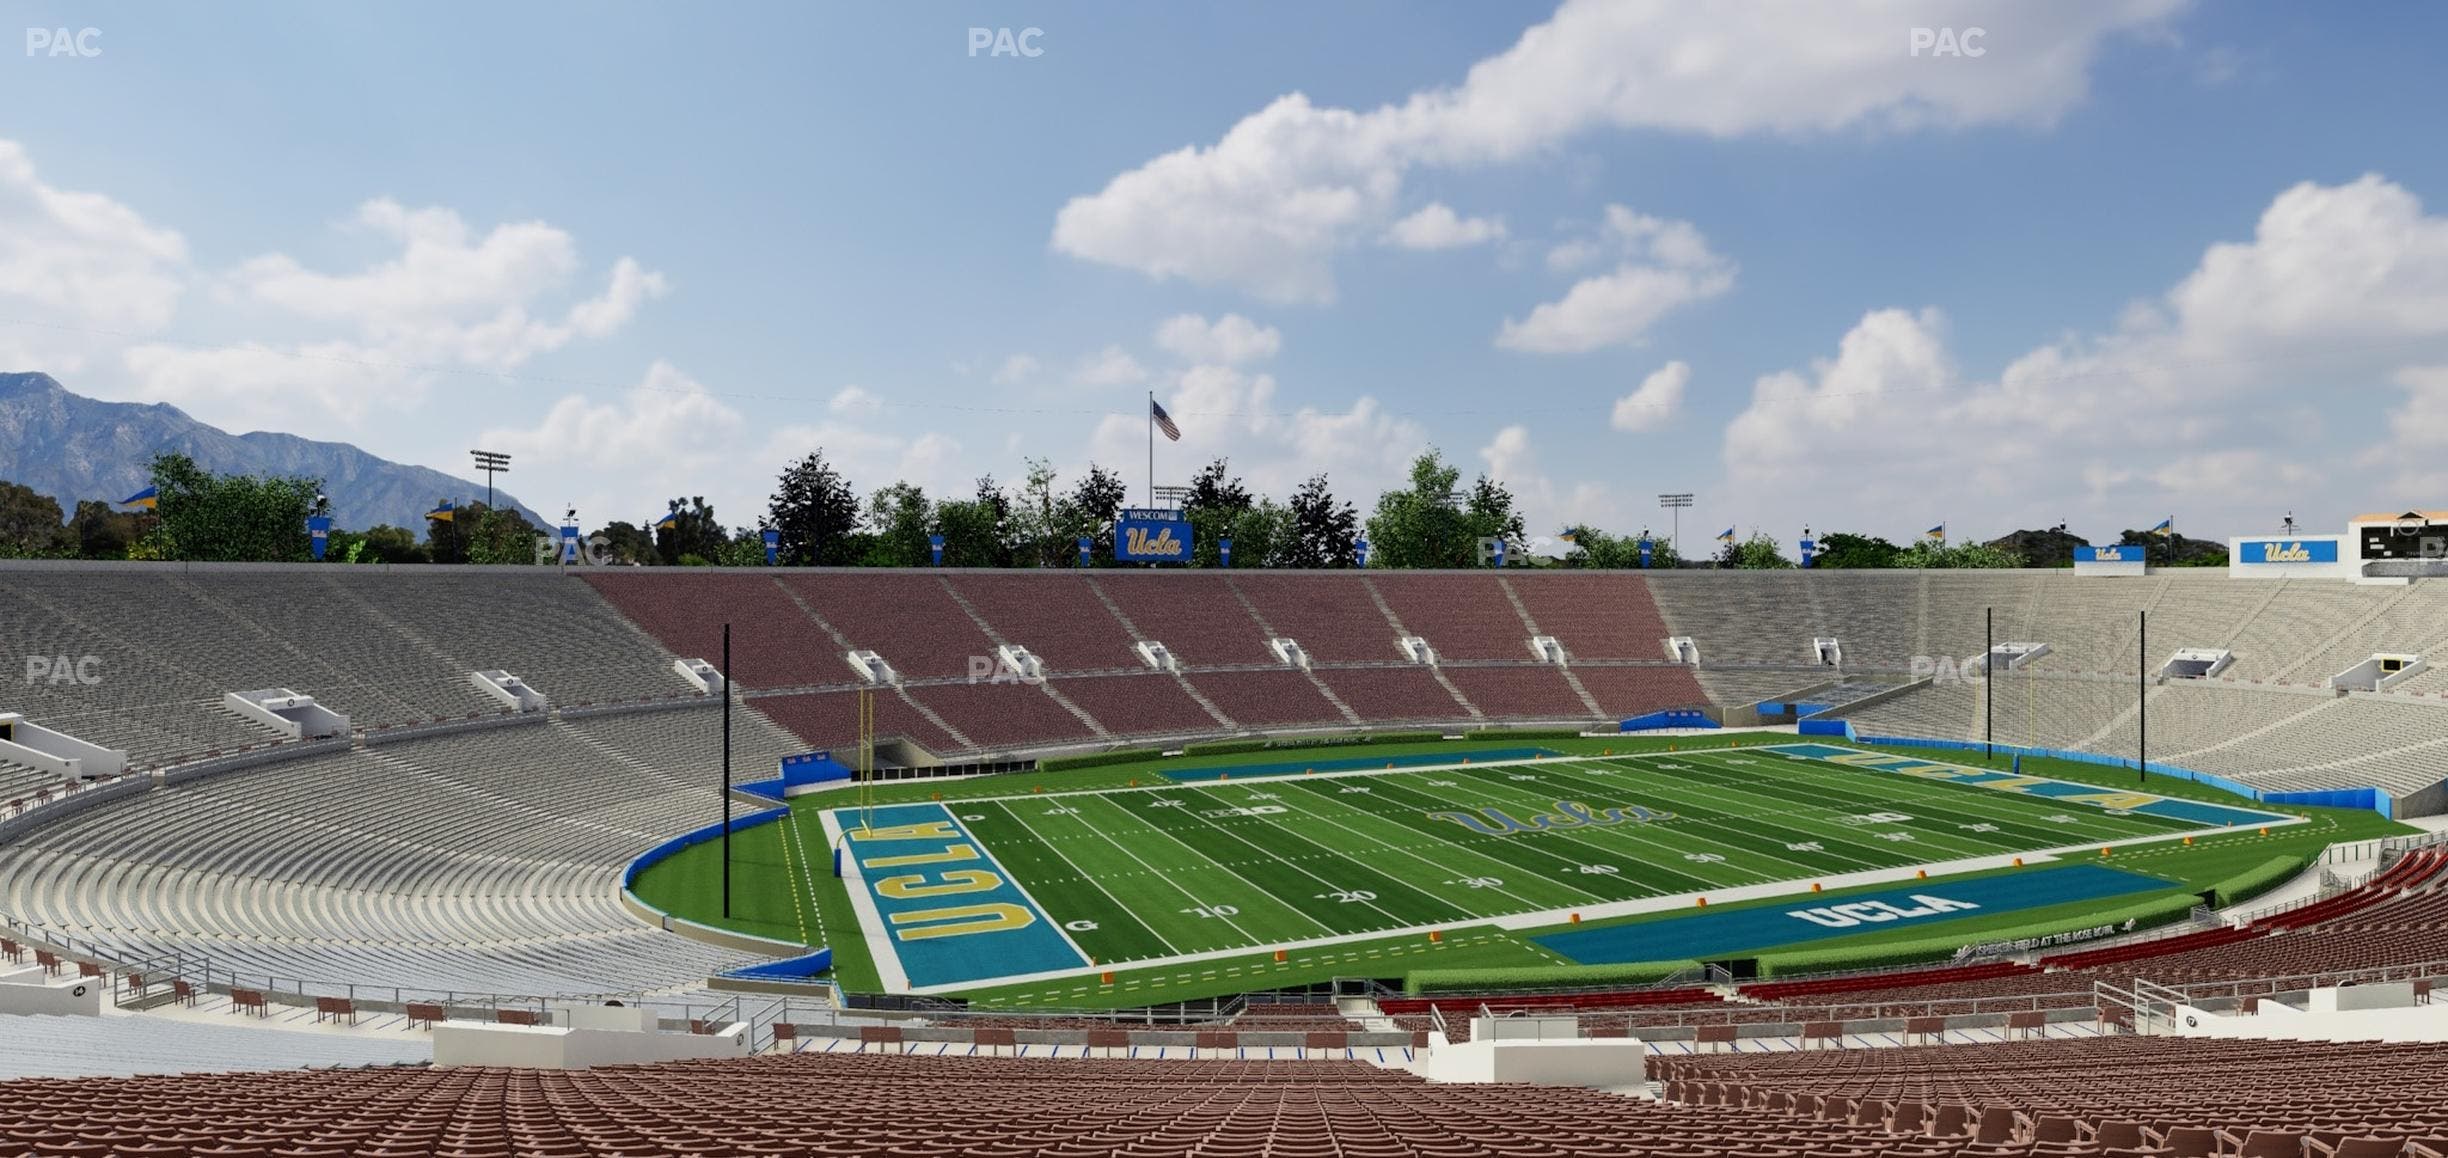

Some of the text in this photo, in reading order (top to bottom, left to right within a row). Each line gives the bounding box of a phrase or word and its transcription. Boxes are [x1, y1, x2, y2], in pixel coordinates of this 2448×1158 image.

[1129, 510, 1169, 520] WESCOM
[1684, 853, 1727, 863] 50
[1580, 864, 1620, 875] 40
[850, 820, 1037, 941] UCLA
[1459, 876, 1504, 888] 30
[1329, 890, 1377, 903] 20
[1191, 904, 1240, 919] 10
[1787, 894, 1982, 928] UCLA
[1065, 919, 1099, 931] G
[2041, 935, 2052, 946] AT
